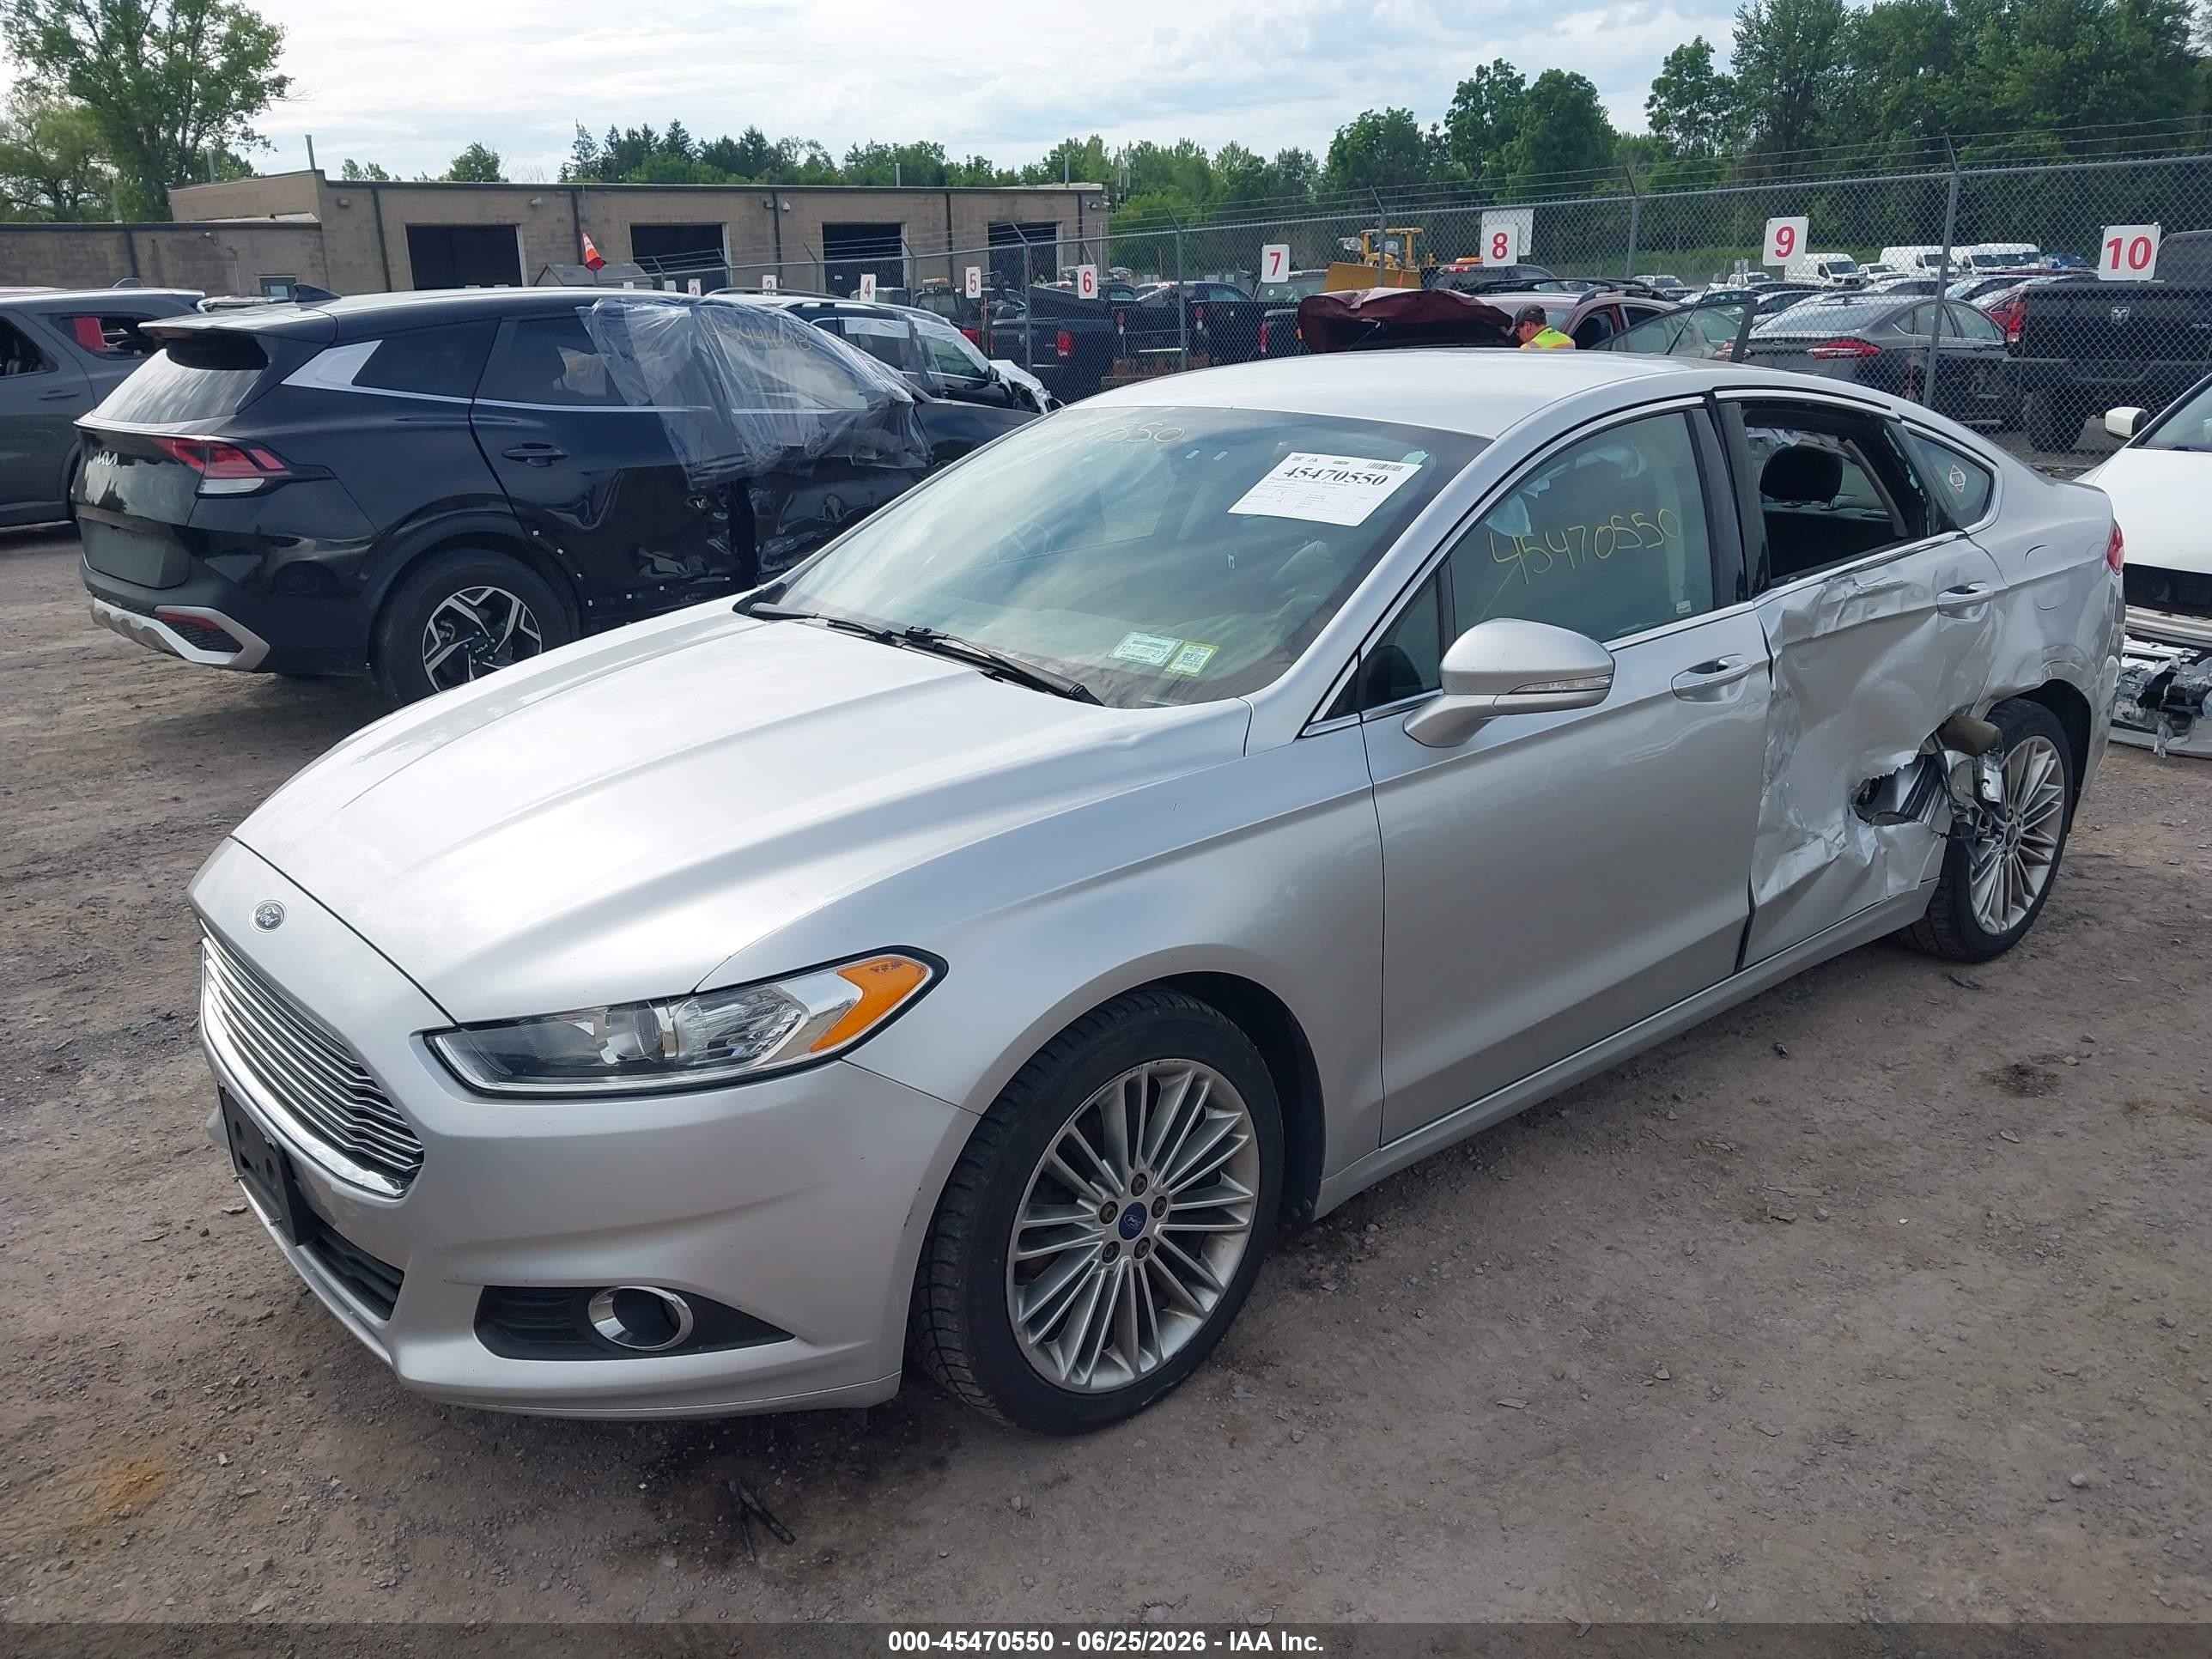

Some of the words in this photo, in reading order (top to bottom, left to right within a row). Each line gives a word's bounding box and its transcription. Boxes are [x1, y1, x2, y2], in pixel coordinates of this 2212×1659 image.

[1492, 232, 1508, 259] 8
[1775, 226, 1796, 258] 9
[2106, 236, 2153, 270] 10
[1268, 251, 1281, 276] 7
[864, 279, 872, 298] 4
[969, 272, 977, 293] 5
[1082, 271, 1092, 294] 6
[1284, 466, 1389, 486] 45470550
[1490, 508, 1681, 584] 45470550
